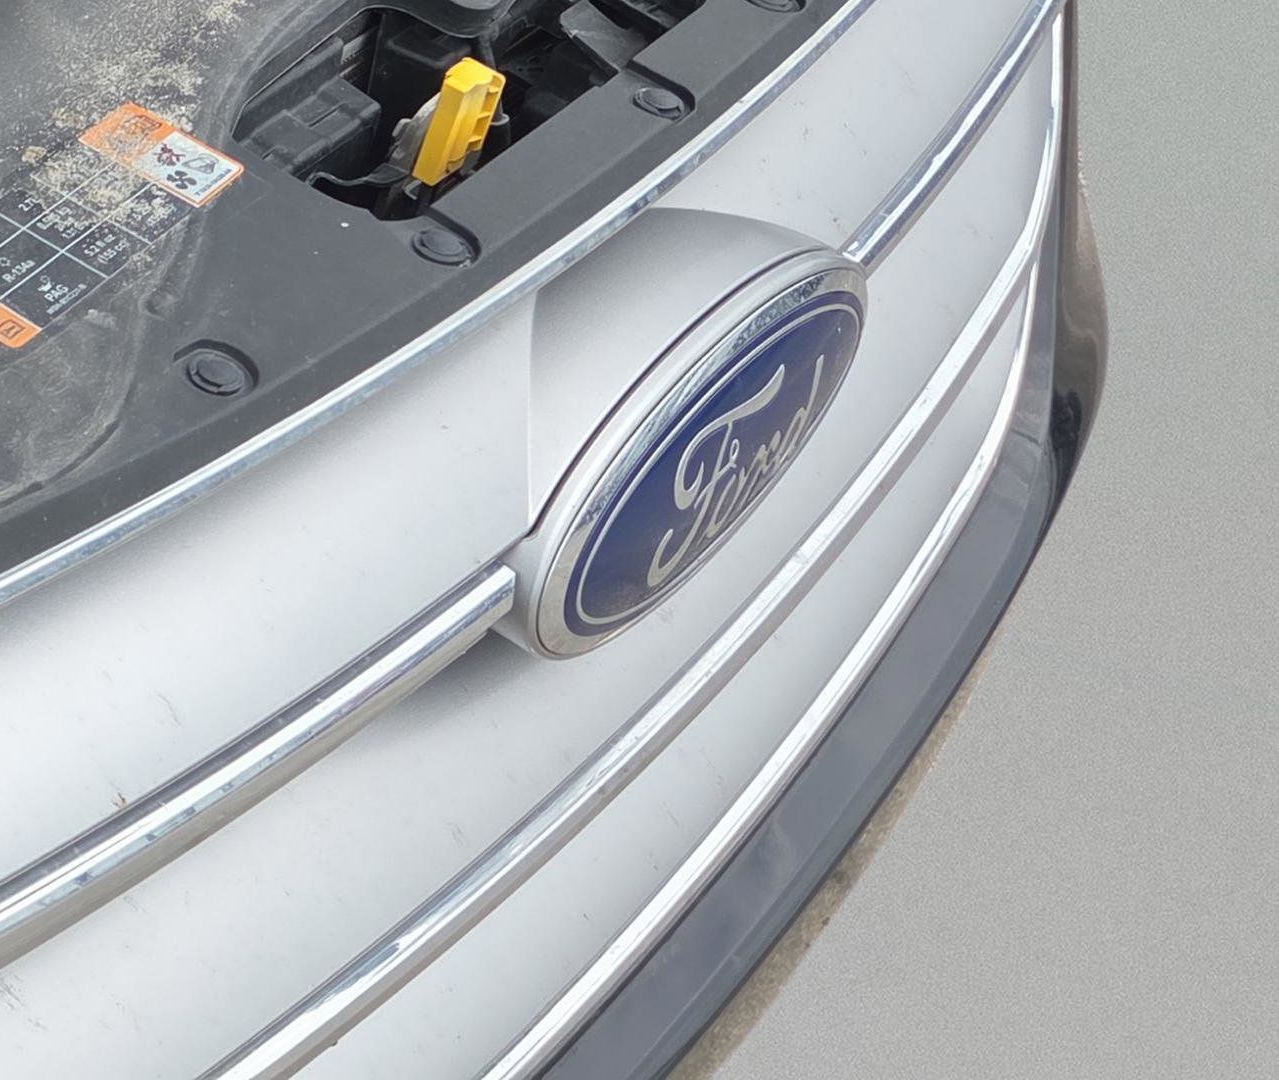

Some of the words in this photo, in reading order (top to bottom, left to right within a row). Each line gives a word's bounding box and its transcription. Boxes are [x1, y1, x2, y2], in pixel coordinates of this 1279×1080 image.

[1, 259, 36, 283] R-134a
[44, 284, 69, 302] PAG
[646, 354, 825, 587] Ford
